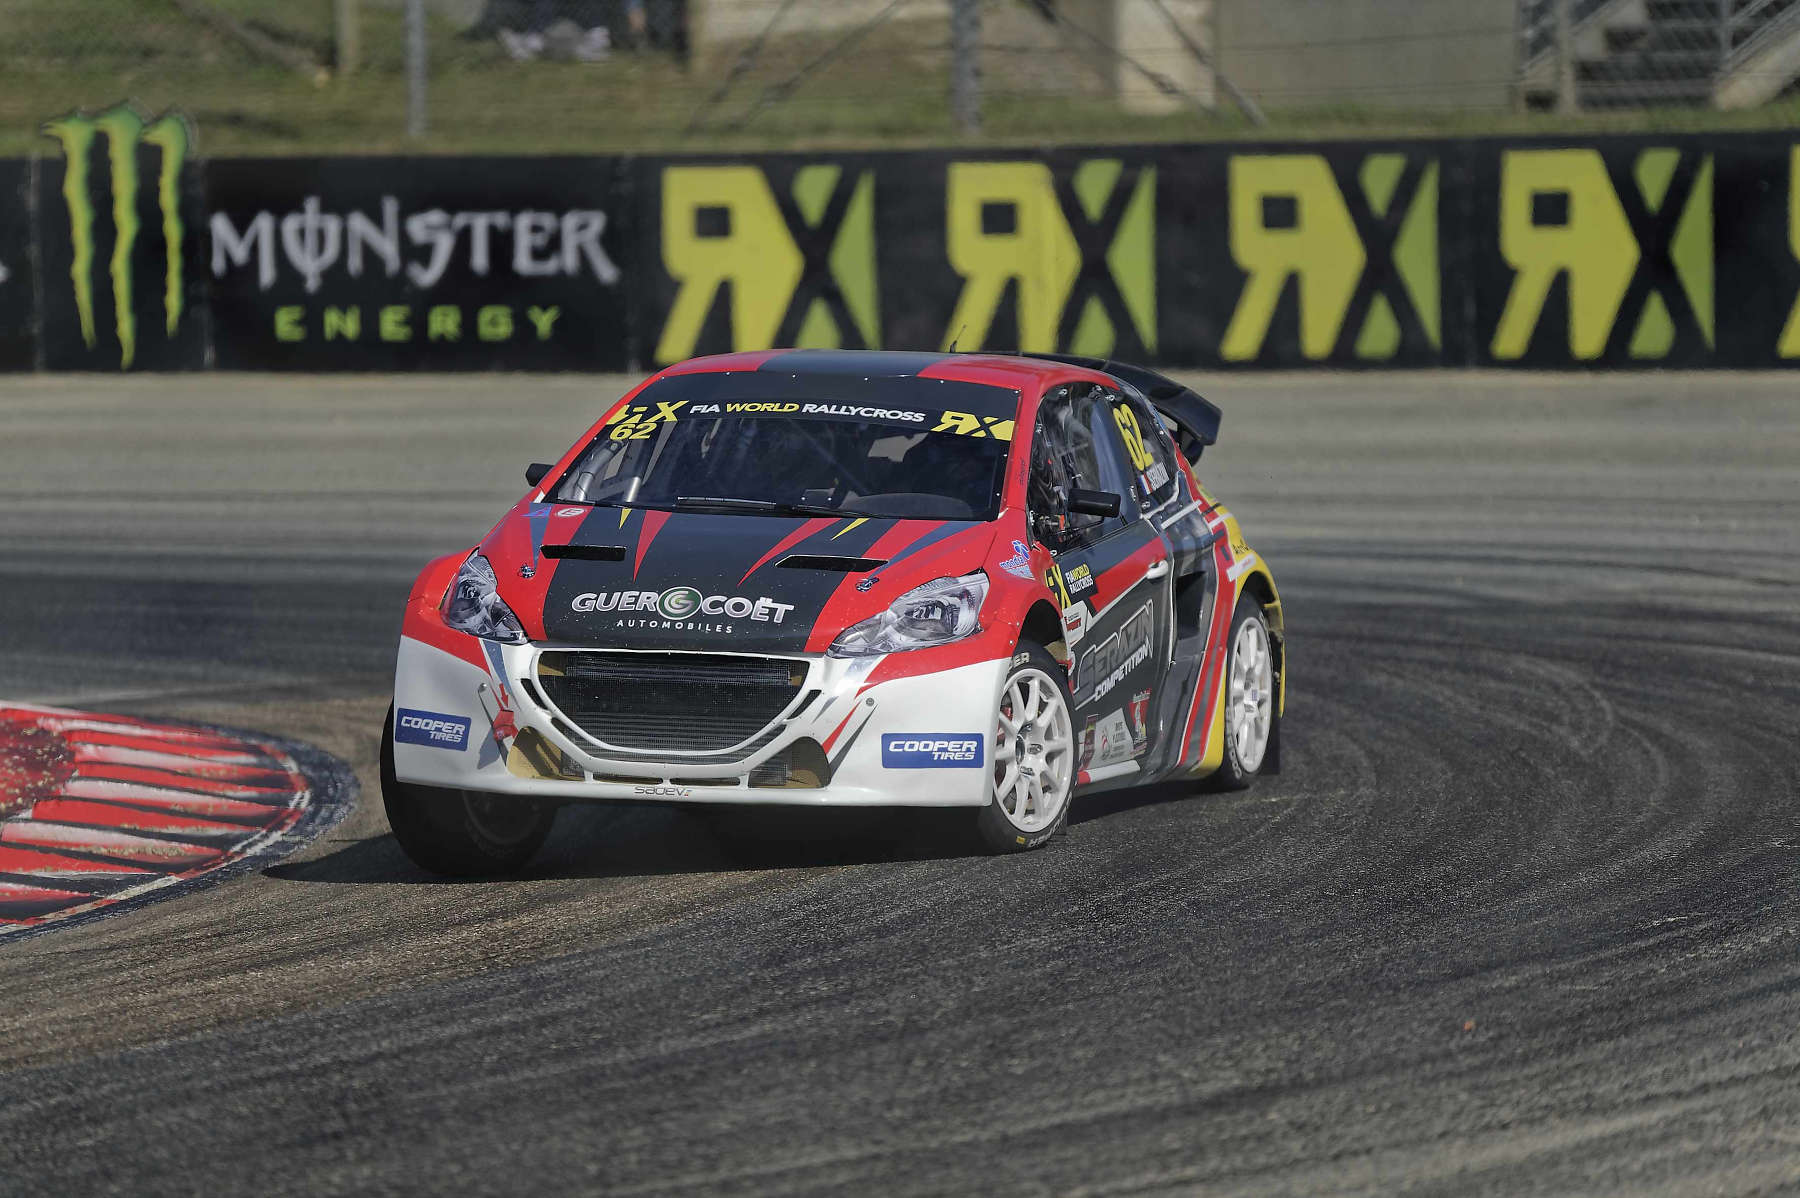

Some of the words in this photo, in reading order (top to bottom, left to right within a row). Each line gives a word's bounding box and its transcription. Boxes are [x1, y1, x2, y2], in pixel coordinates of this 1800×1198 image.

[209, 196, 620, 292] MONSTER
[274, 305, 561, 342] ENERGY
[689, 403, 721, 414] FIA
[726, 402, 801, 414] WORLD
[801, 403, 927, 423] RALLYCROSS
[609, 422, 658, 441] 62
[1112, 403, 1154, 471] 62
[617, 619, 733, 634] AUTOMOBILES
[1094, 637, 1150, 702] COMPETITION
[400, 716, 466, 735] COOPER
[429, 730, 463, 743] TIRES
[888, 740, 978, 752] COOPER
[932, 751, 976, 761] TIRES
